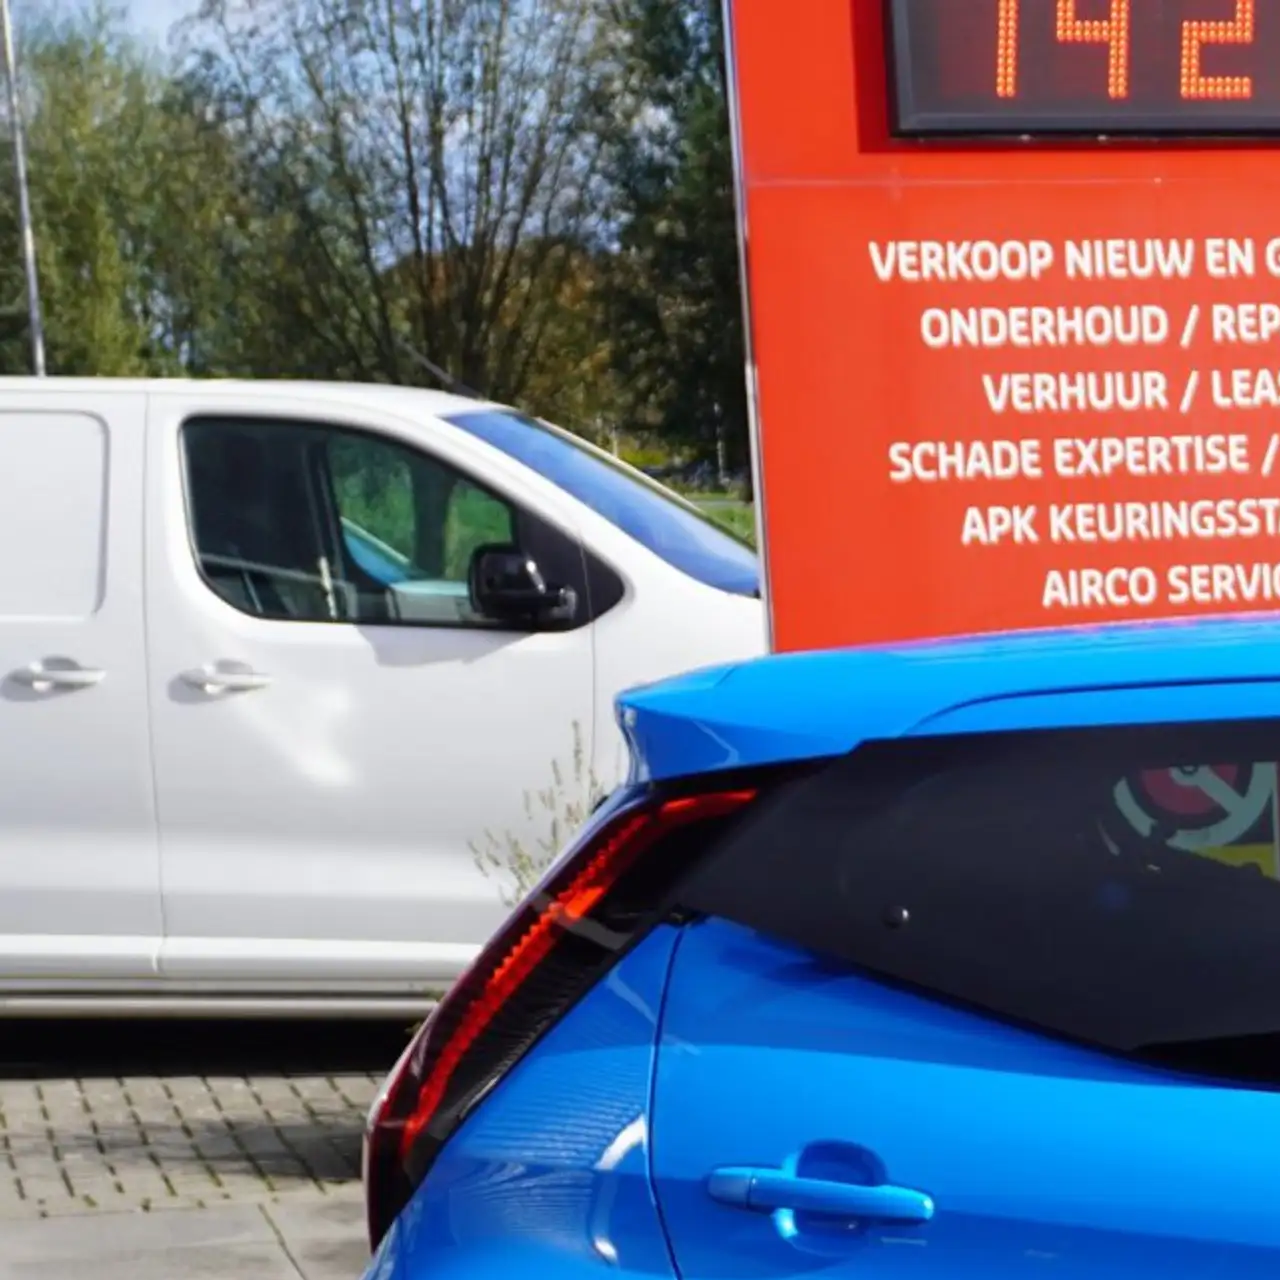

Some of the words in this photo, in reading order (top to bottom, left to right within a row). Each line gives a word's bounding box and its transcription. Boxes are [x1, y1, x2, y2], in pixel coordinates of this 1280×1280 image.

[868, 239, 1055, 282] VERKOOP
[1064, 238, 1196, 280] NIEUW
[1204, 237, 1256, 279] EN
[920, 304, 1170, 349] ONDERHOUD
[1179, 303, 1201, 349] /
[981, 370, 1170, 414] VERHUUR
[1179, 369, 1200, 415] /
[888, 438, 1044, 482] SCHADE
[1053, 433, 1251, 478] EXPERTISE
[1260, 432, 1280, 478] /
[961, 502, 1040, 546] APK
[1041, 566, 1158, 609] AIRCO
